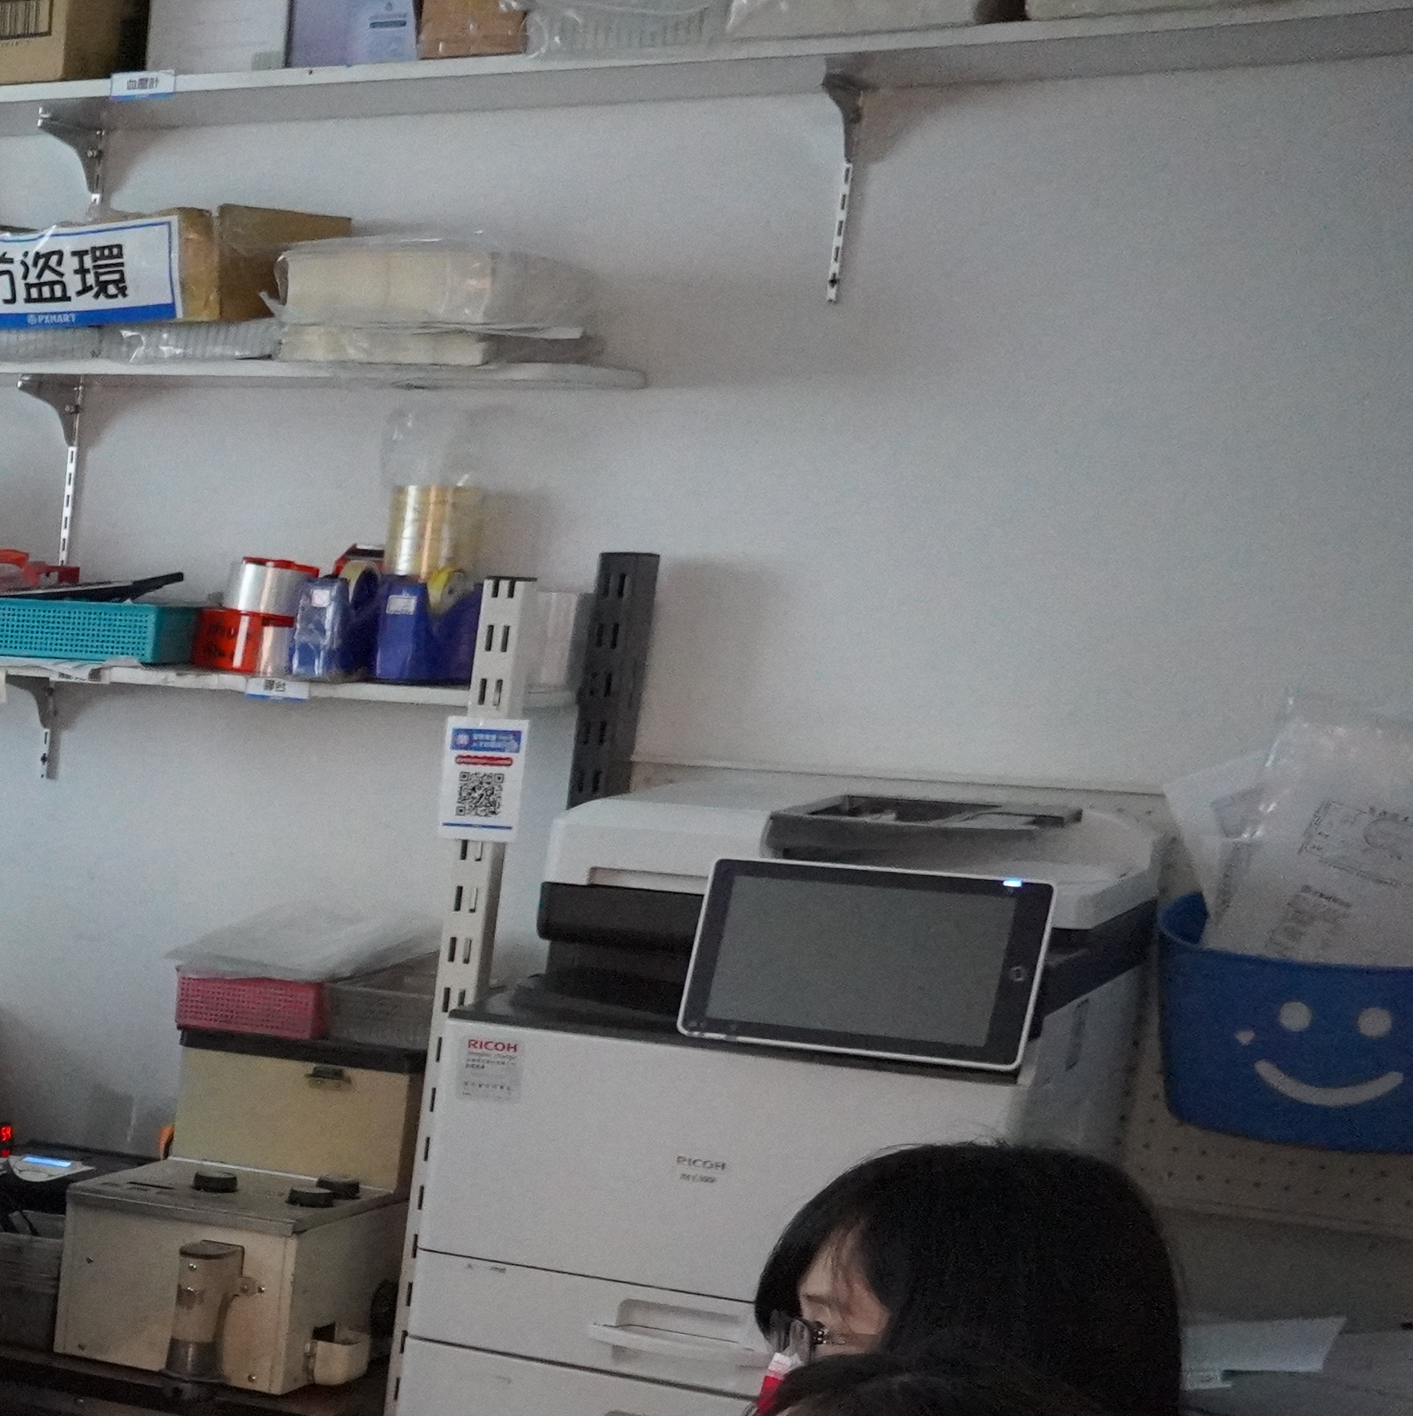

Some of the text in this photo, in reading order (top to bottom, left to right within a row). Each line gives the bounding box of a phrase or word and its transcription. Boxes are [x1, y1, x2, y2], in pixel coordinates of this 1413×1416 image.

[38, 313, 77, 325] PXMART
[467, 1039, 518, 1053] RICOH
[676, 1155, 726, 1171] RICOH
